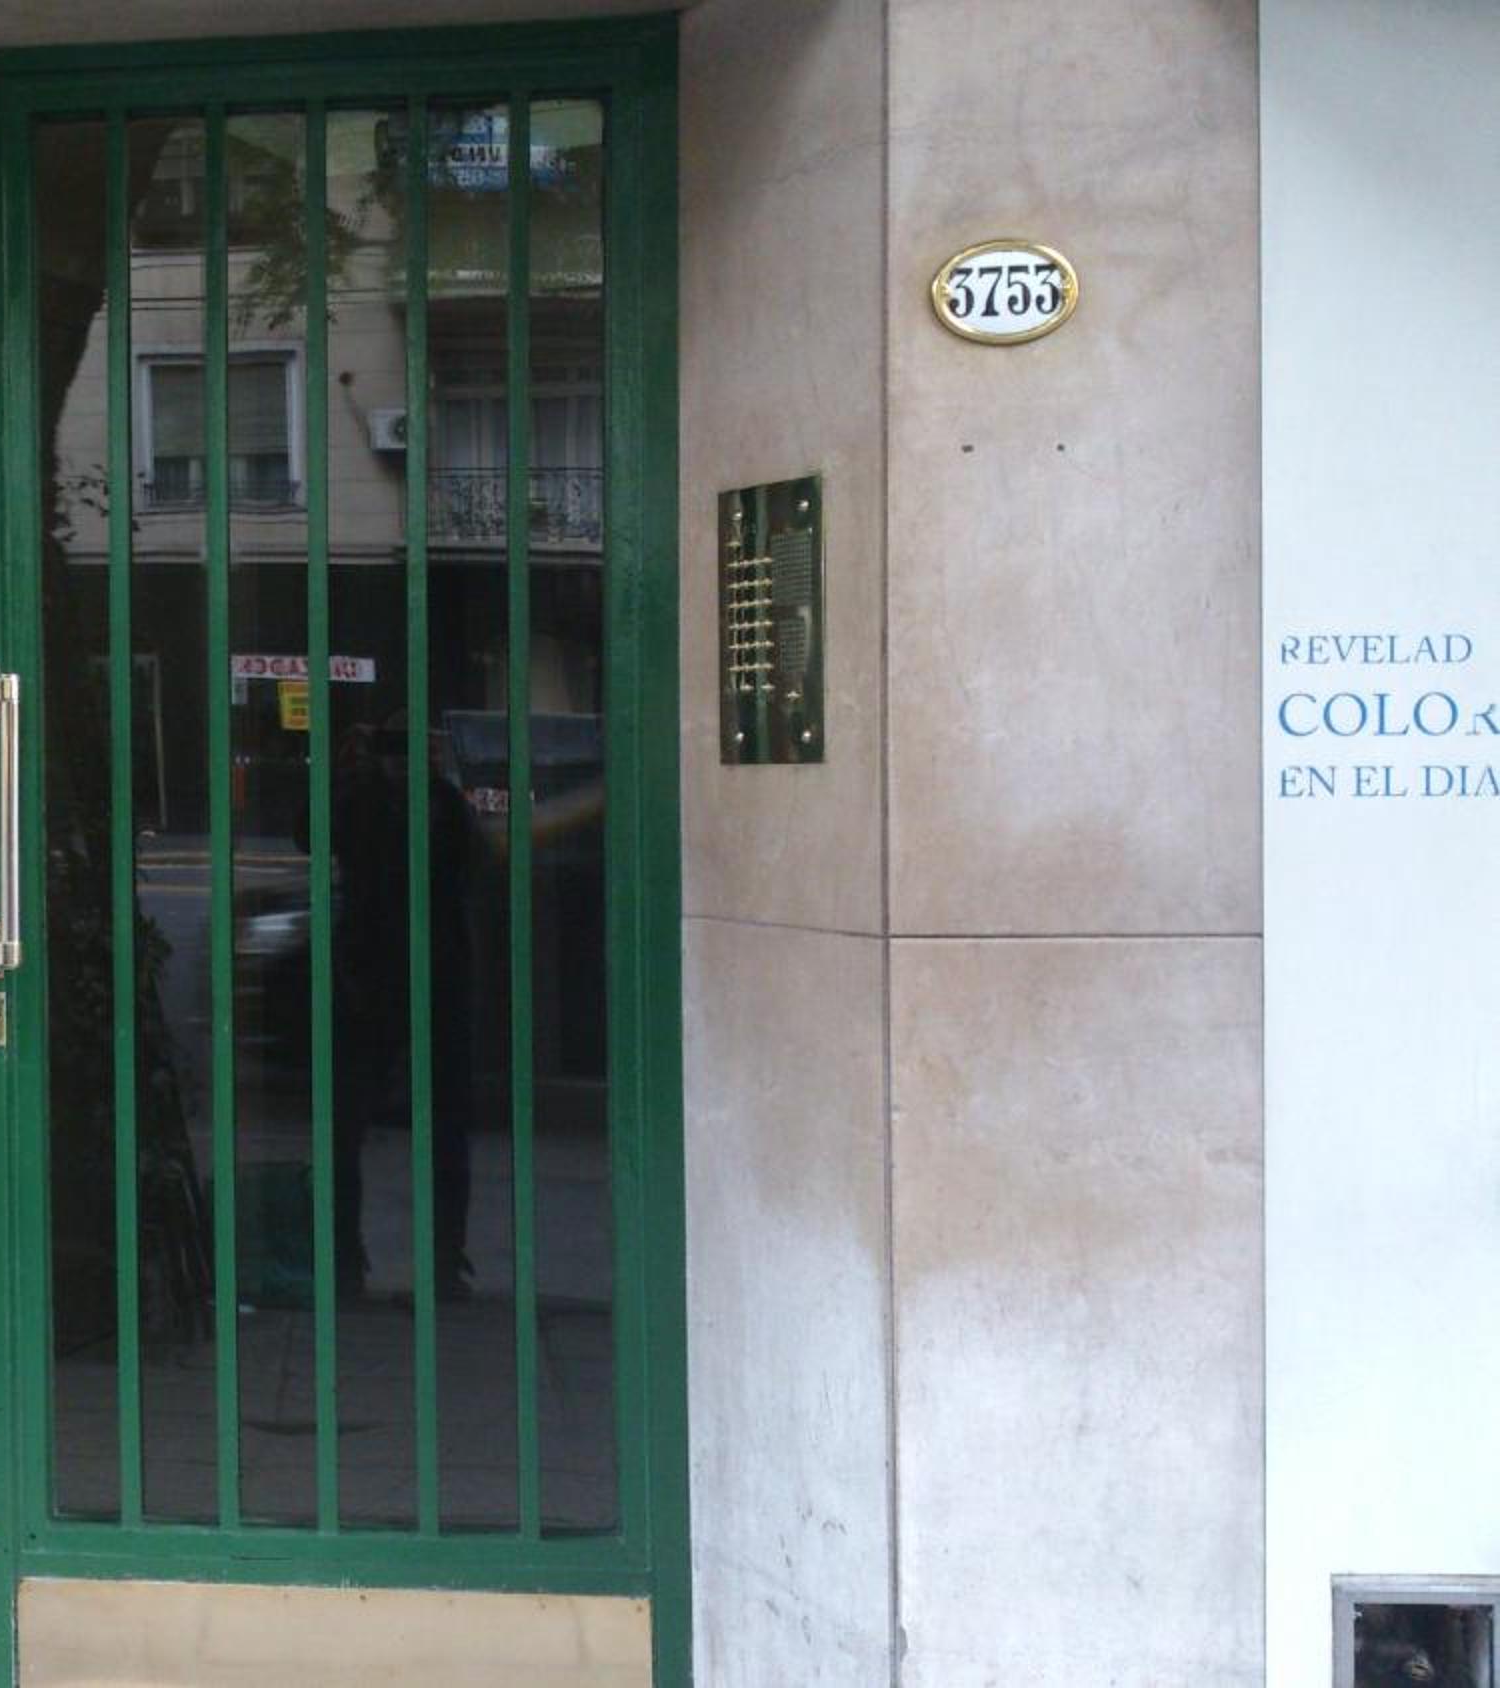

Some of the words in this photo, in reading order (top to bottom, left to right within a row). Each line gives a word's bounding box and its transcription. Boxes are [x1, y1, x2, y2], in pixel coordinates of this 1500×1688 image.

[949, 263, 1060, 318] 3753
[1280, 634, 1473, 665] REVELAD
[1279, 765, 1337, 798] EN
[1352, 765, 1409, 798] EL
[1420, 764, 1500, 798] DIA
